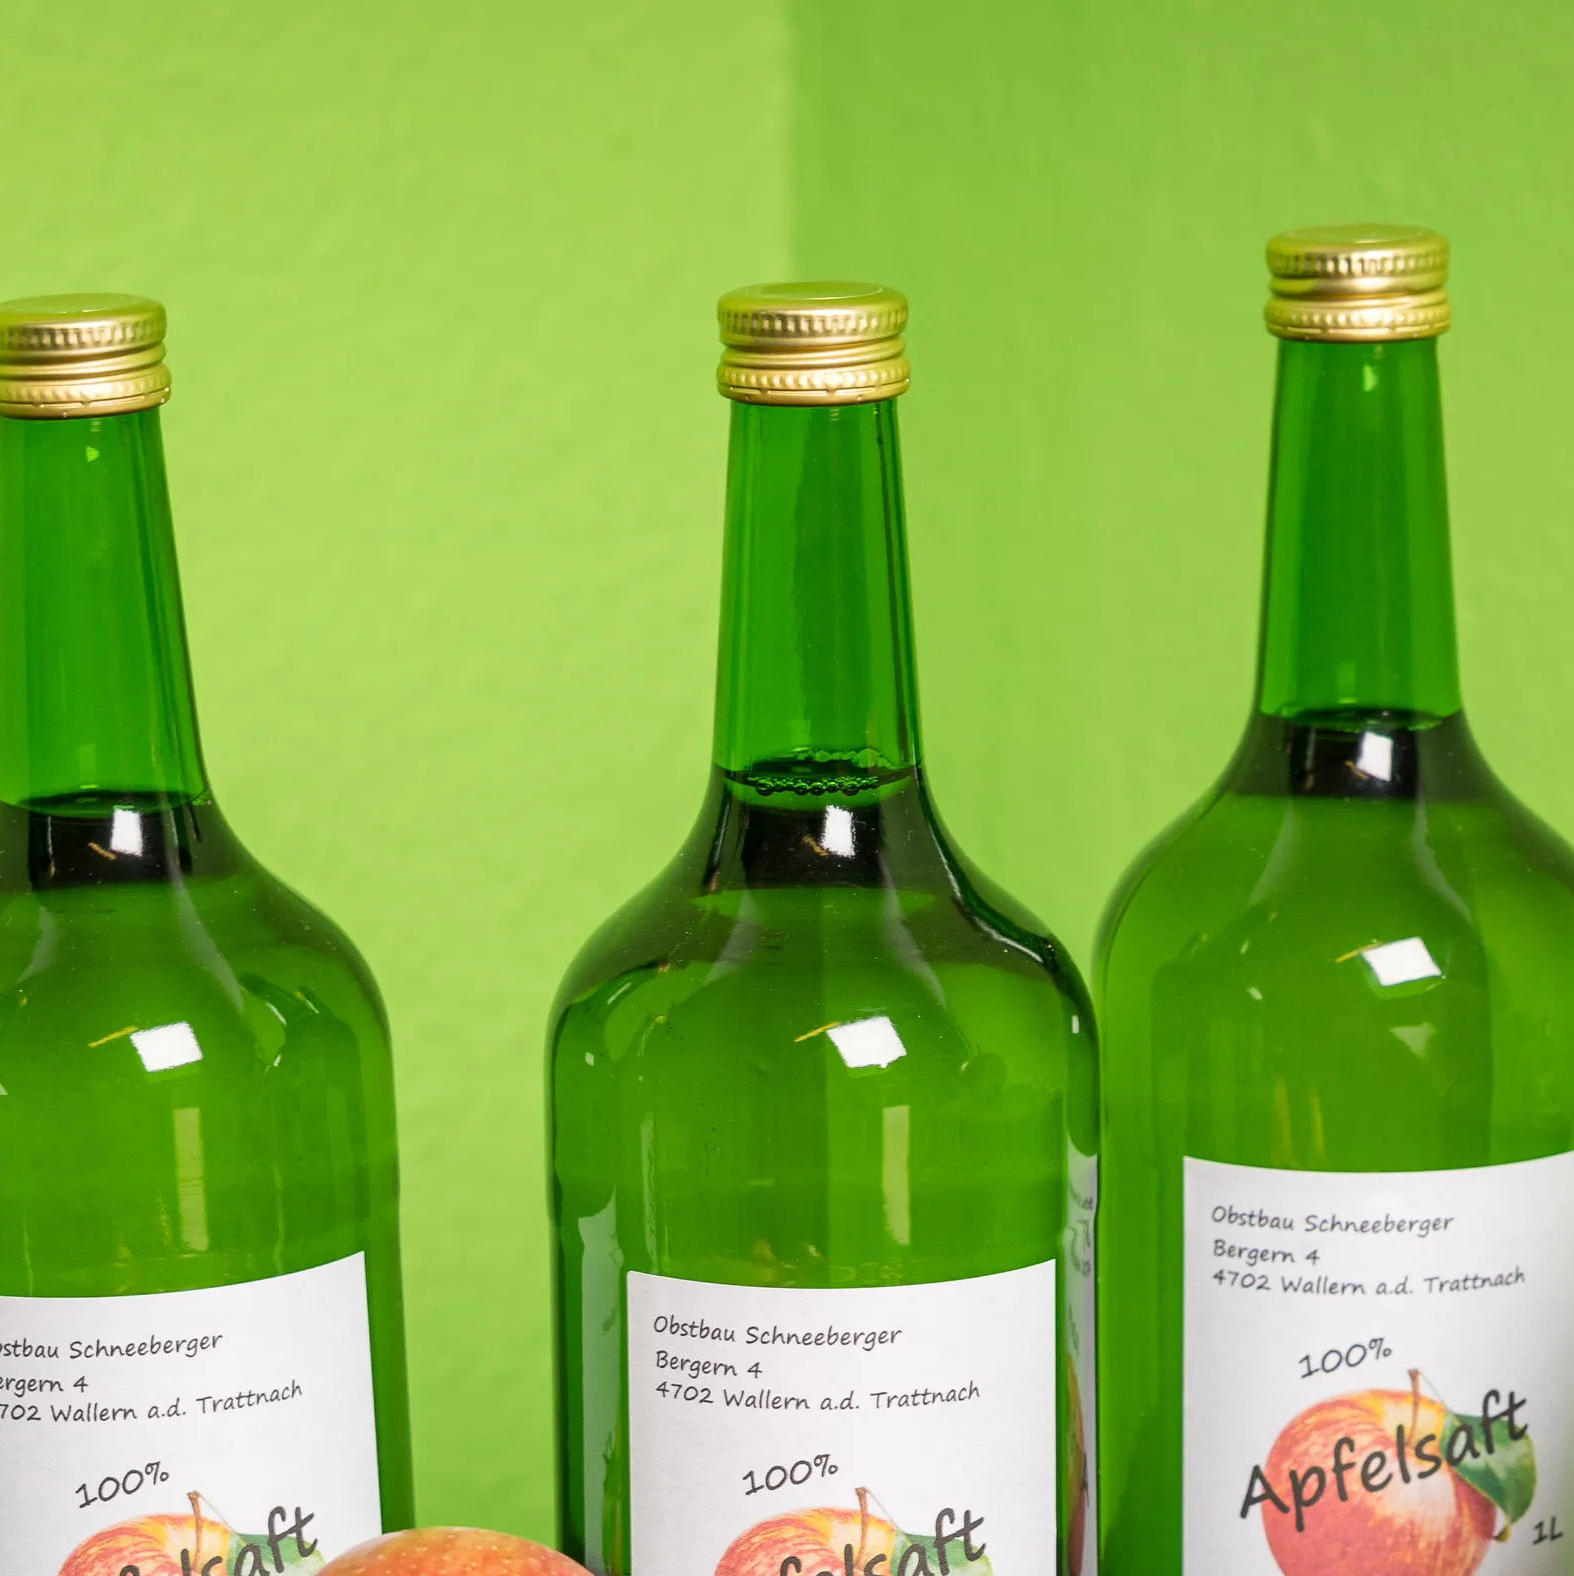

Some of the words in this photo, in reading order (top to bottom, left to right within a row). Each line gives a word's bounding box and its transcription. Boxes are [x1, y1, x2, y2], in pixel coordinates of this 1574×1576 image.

[1211, 1205, 1294, 1231] Obstbau
[1304, 1213, 1454, 1238] Schneeberger
[1213, 1238, 1295, 1268] Bergern
[1305, 1249, 1320, 1265] 4
[1212, 1269, 1271, 1291] 4702
[1281, 1276, 1366, 1295] Wallern
[1375, 1276, 1413, 1295] a.d.
[1424, 1266, 1525, 1293] Trattnach
[69, 1334, 224, 1360] Schneeberger
[653, 1313, 736, 1343] Obstbau
[745, 1324, 903, 1352] Schneeberger
[655, 1349, 738, 1380] Bergern
[746, 1361, 763, 1379] 4
[1298, 1337, 1392, 1379] 100%
[72, 1375, 89, 1393] 4
[655, 1380, 714, 1404] 4702
[723, 1388, 811, 1410] Wallern
[819, 1390, 860, 1411] a.d.
[869, 1379, 981, 1409] Trattnach
[49, 1402, 138, 1423] Wallern
[147, 1399, 187, 1419] a.d.
[195, 1378, 303, 1414] Trattnach
[742, 1453, 839, 1496] 100%
[1240, 1389, 1529, 1533] Apfelsaft
[74, 1460, 170, 1509] 100%
[1532, 1516, 1564, 1546] 1L
